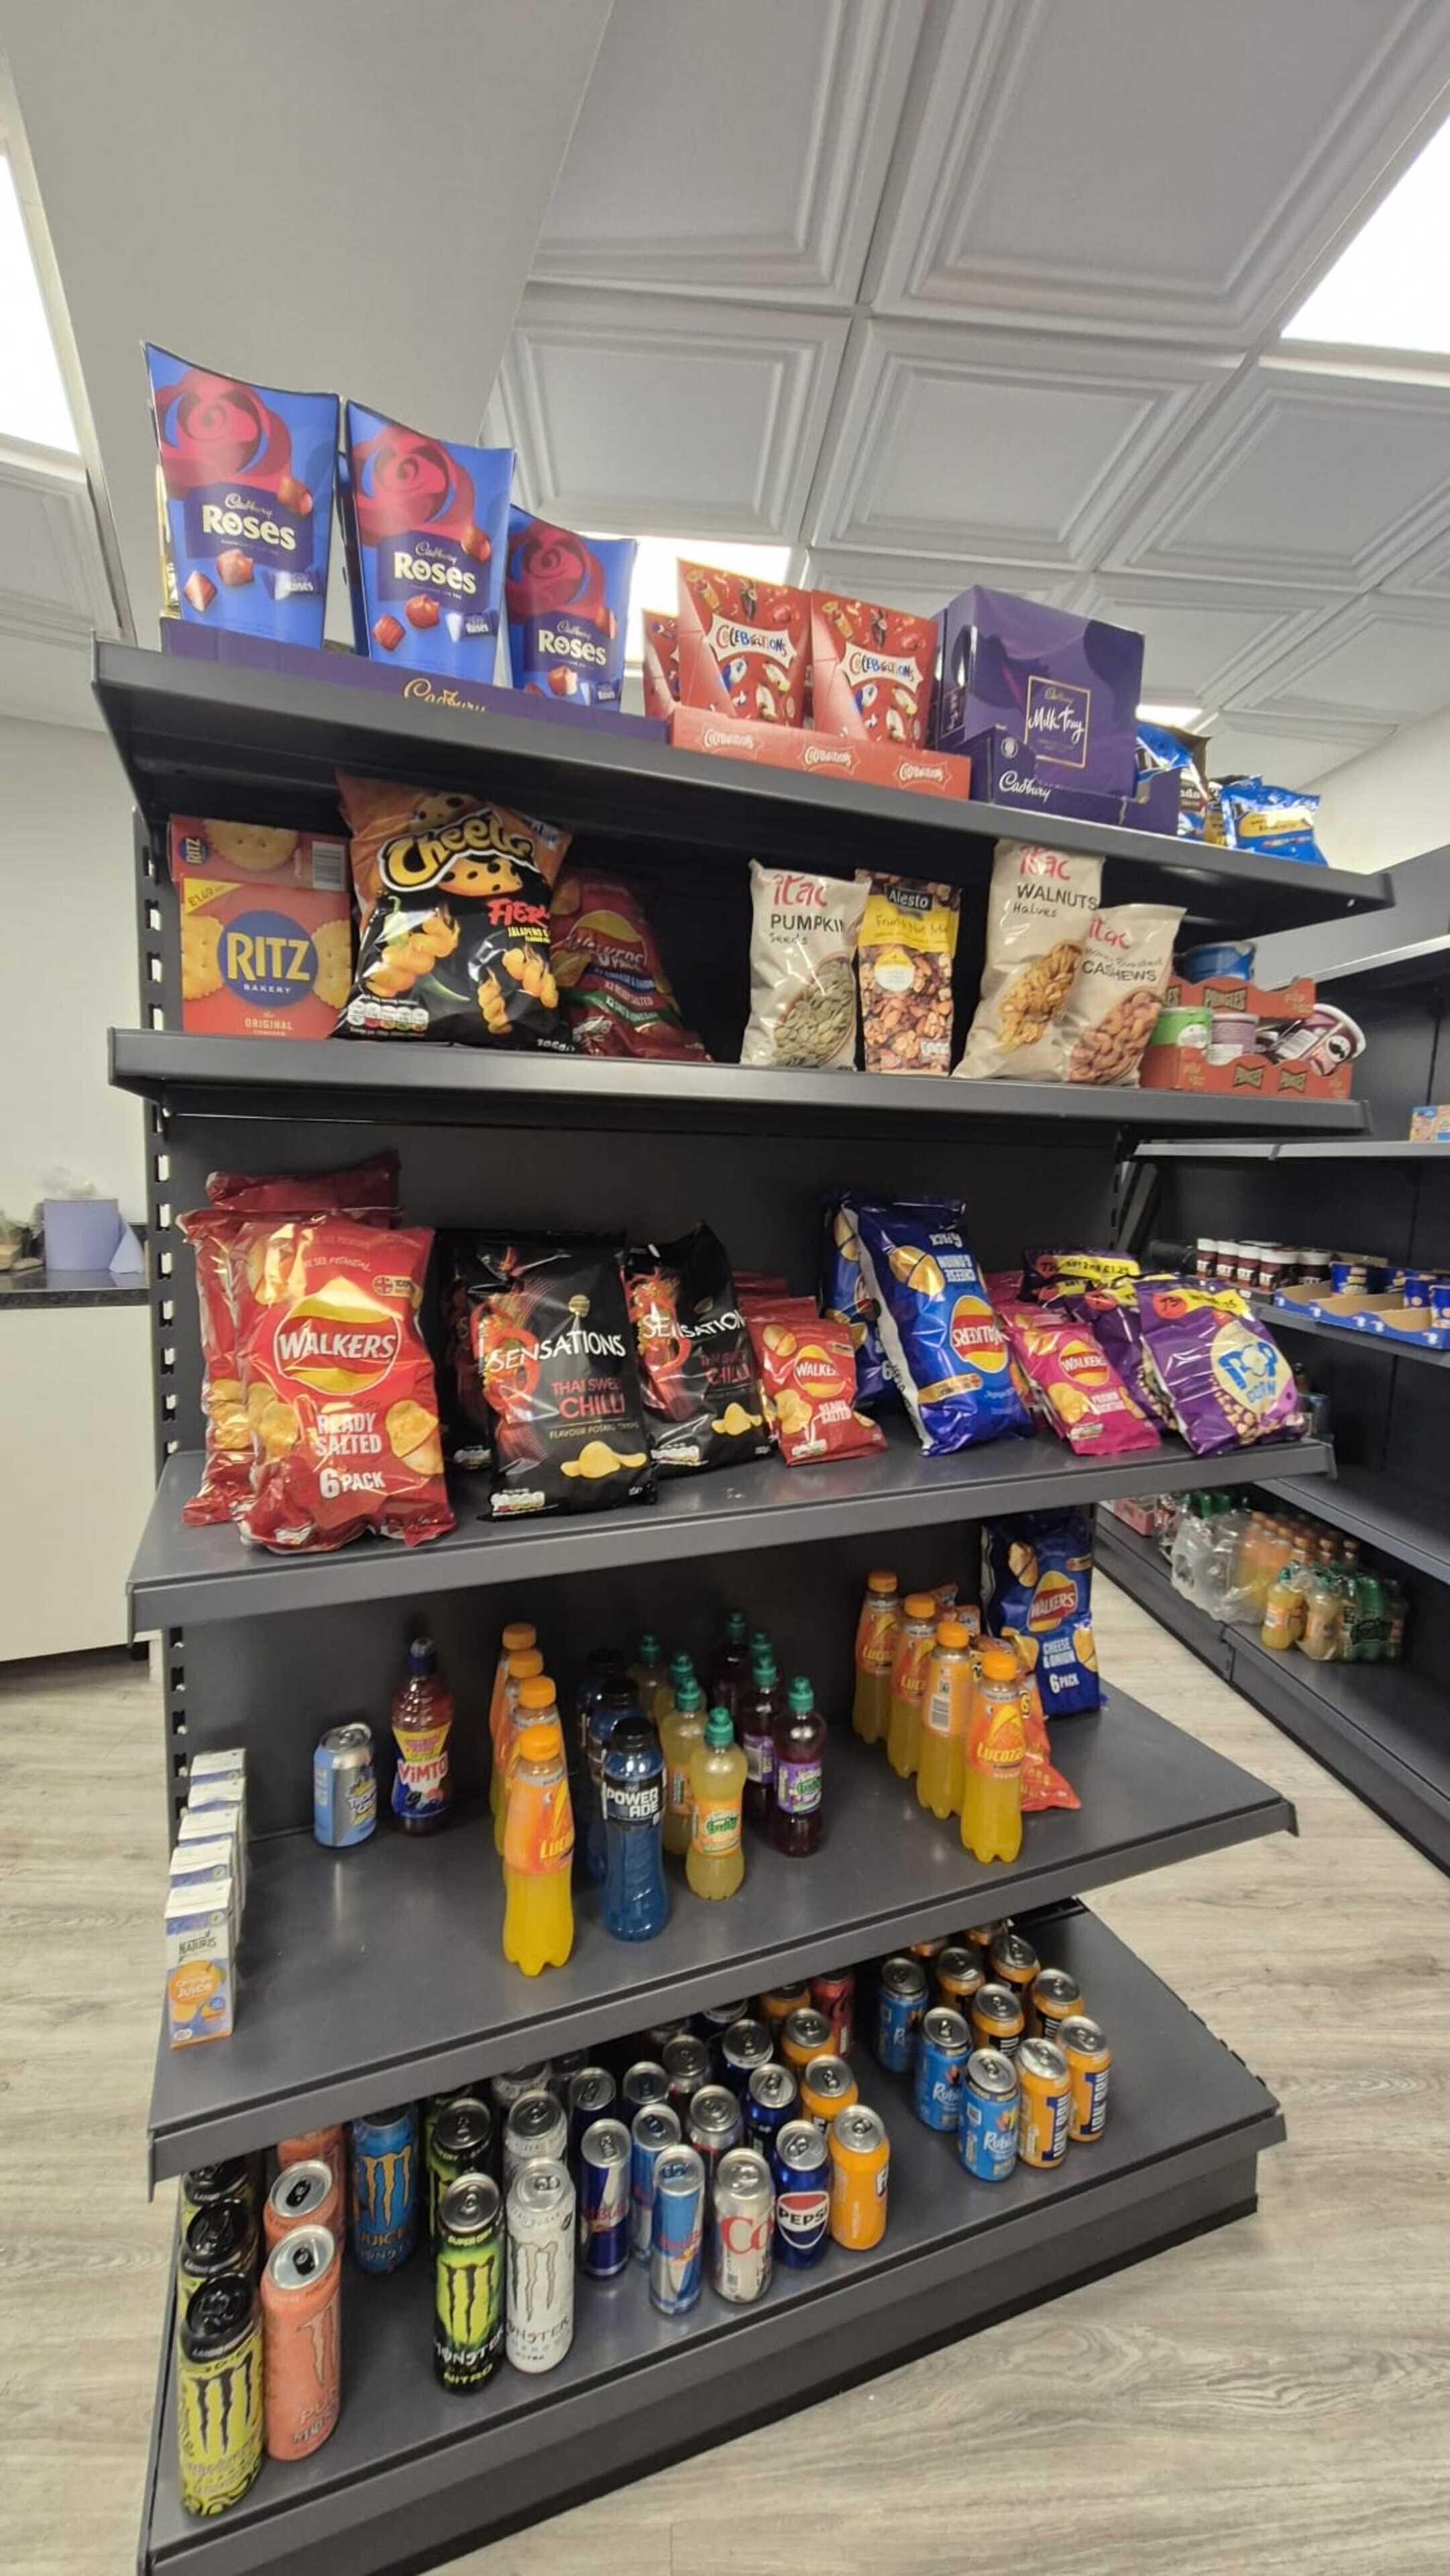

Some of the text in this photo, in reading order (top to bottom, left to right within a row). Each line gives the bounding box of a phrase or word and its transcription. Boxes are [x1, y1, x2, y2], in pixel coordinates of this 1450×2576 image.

[202, 504, 296, 550] Roses
[394, 551, 477, 594] Roses
[538, 629, 607, 666] Roses
[1028, 704, 1085, 745] Milk Tray
[998, 770, 1052, 804] Cadbury
[185, 838, 202, 864] RITZ
[188, 887, 215, 908] £1.49
[889, 890, 929, 909] Alesto
[1017, 883, 1100, 911] WALNUTS
[1012, 902, 1058, 918] Halves
[227, 931, 311, 982] RITZ
[1080, 959, 1157, 983] CASHEWS
[243, 983, 292, 995] BAKERY
[244, 1018, 293, 1031] ORIGINAL
[278, 1332, 397, 1360] WALKERS
[484, 1330, 626, 1373] SENSATIONS
[552, 1378, 585, 1396] THAI
[559, 1393, 626, 1420] CHILLI
[316, 1412, 378, 1434] READY
[316, 1433, 383, 1456] SALTED
[319, 1467, 387, 1499] 6 PACK
[1049, 1672, 1060, 1694] 6
[606, 1786, 659, 1807] POWER
[629, 1801, 659, 1819] ADE
[443, 2362, 493, 2385] NITRO
